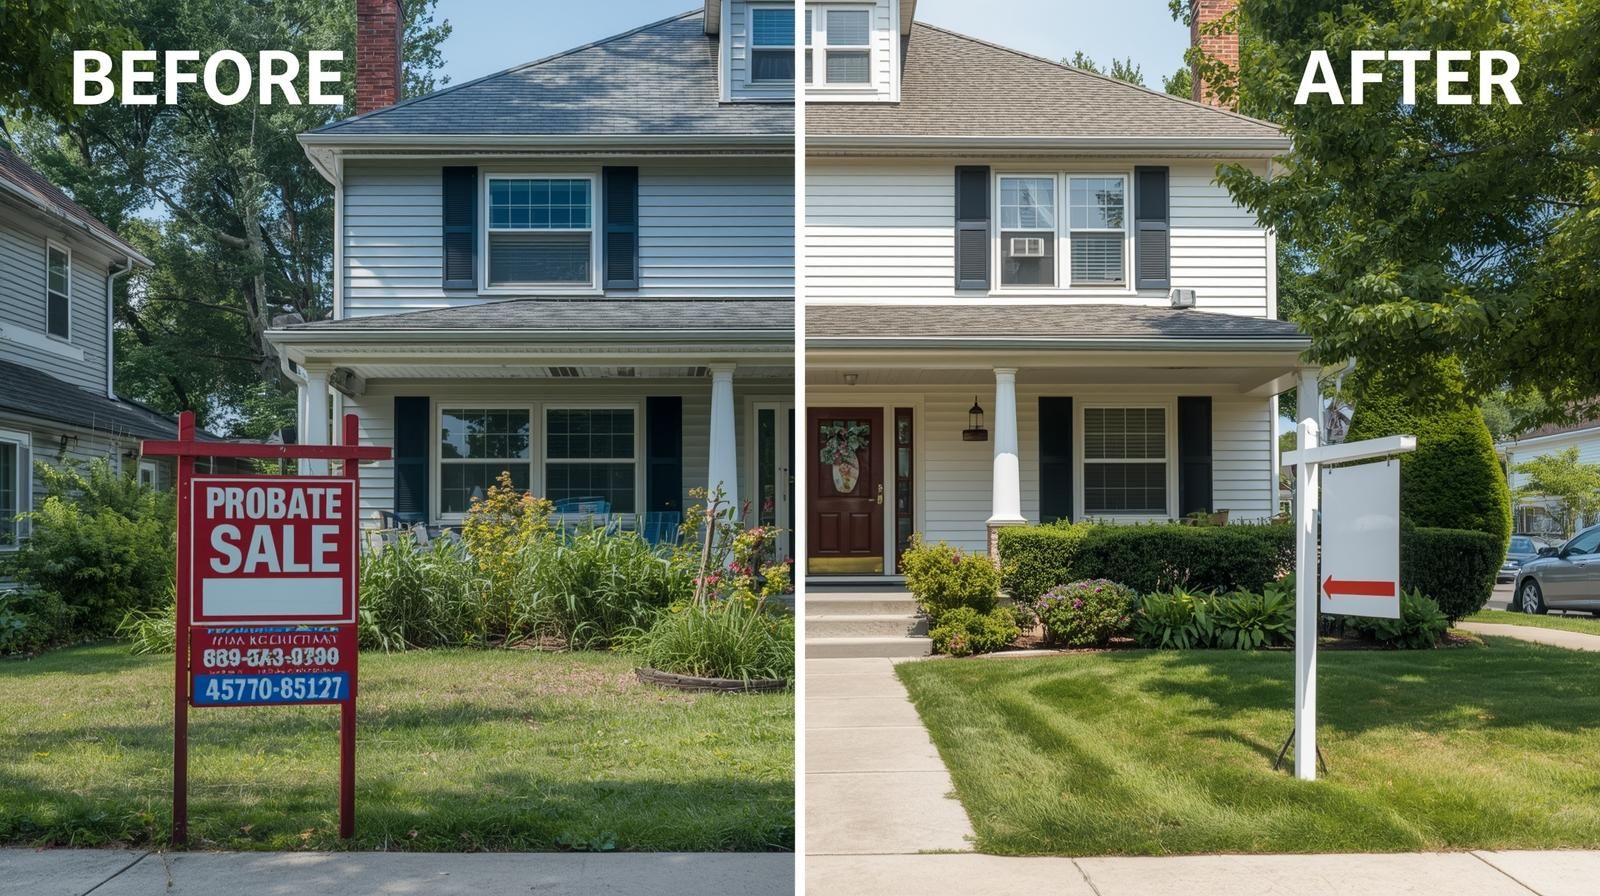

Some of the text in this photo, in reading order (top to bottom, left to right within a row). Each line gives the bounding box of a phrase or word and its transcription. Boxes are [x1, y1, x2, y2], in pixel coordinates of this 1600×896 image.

[206, 487, 342, 520] PROBATE
[209, 523, 340, 574] SALE
[206, 677, 342, 701] 45770-85127
